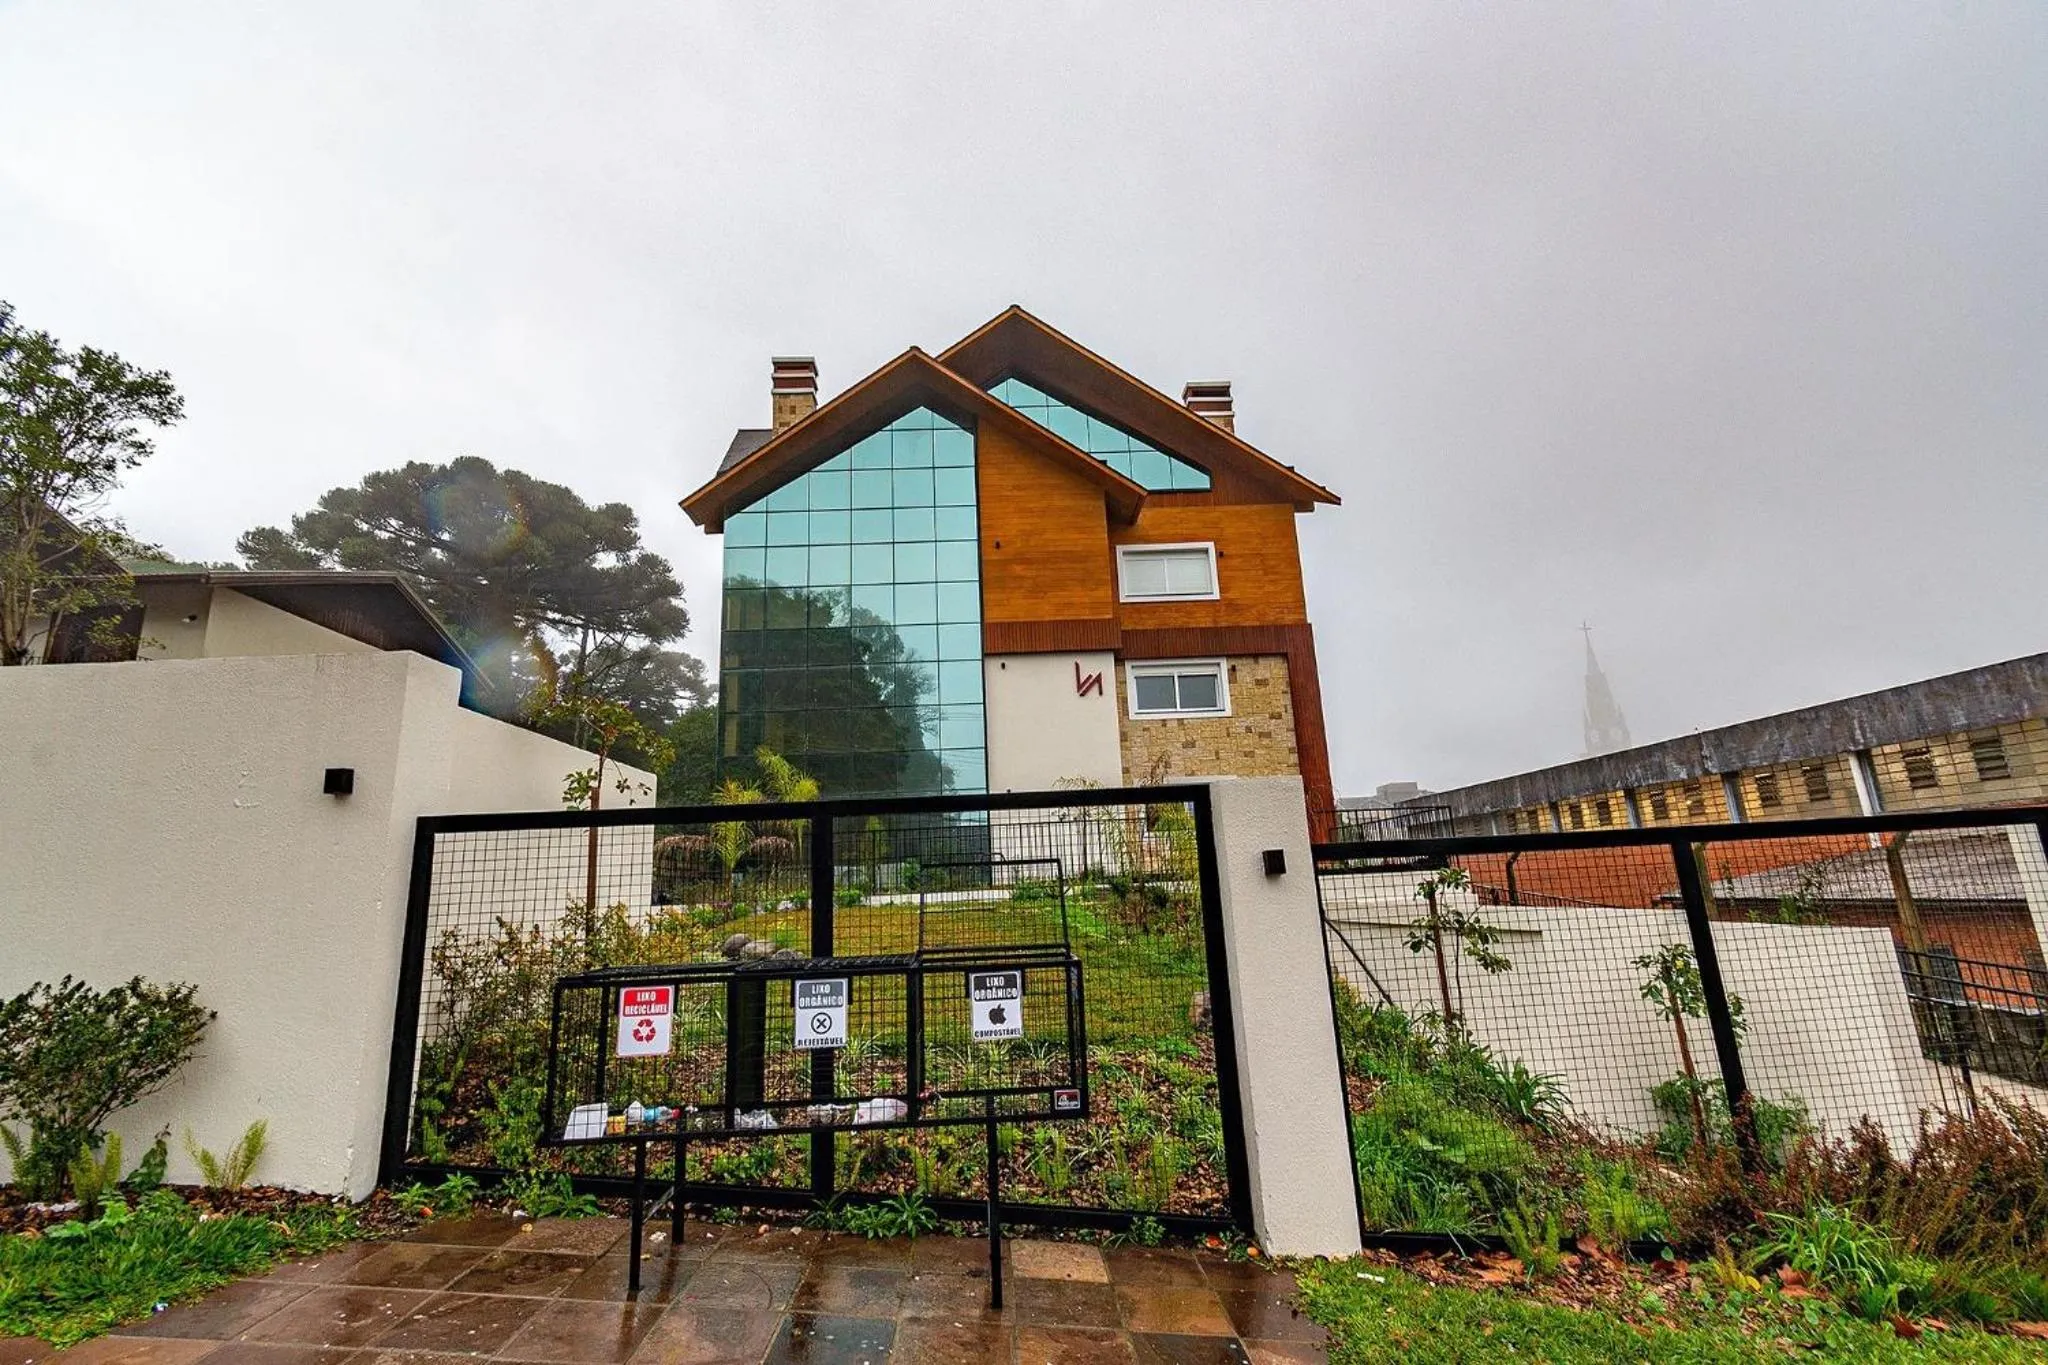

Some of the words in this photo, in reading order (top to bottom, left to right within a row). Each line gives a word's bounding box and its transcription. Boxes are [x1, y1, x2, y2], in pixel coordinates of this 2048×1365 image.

[986, 976, 1004, 987] LIXO
[811, 983, 831, 995] LIXO
[636, 991, 656, 1002] LIXO
